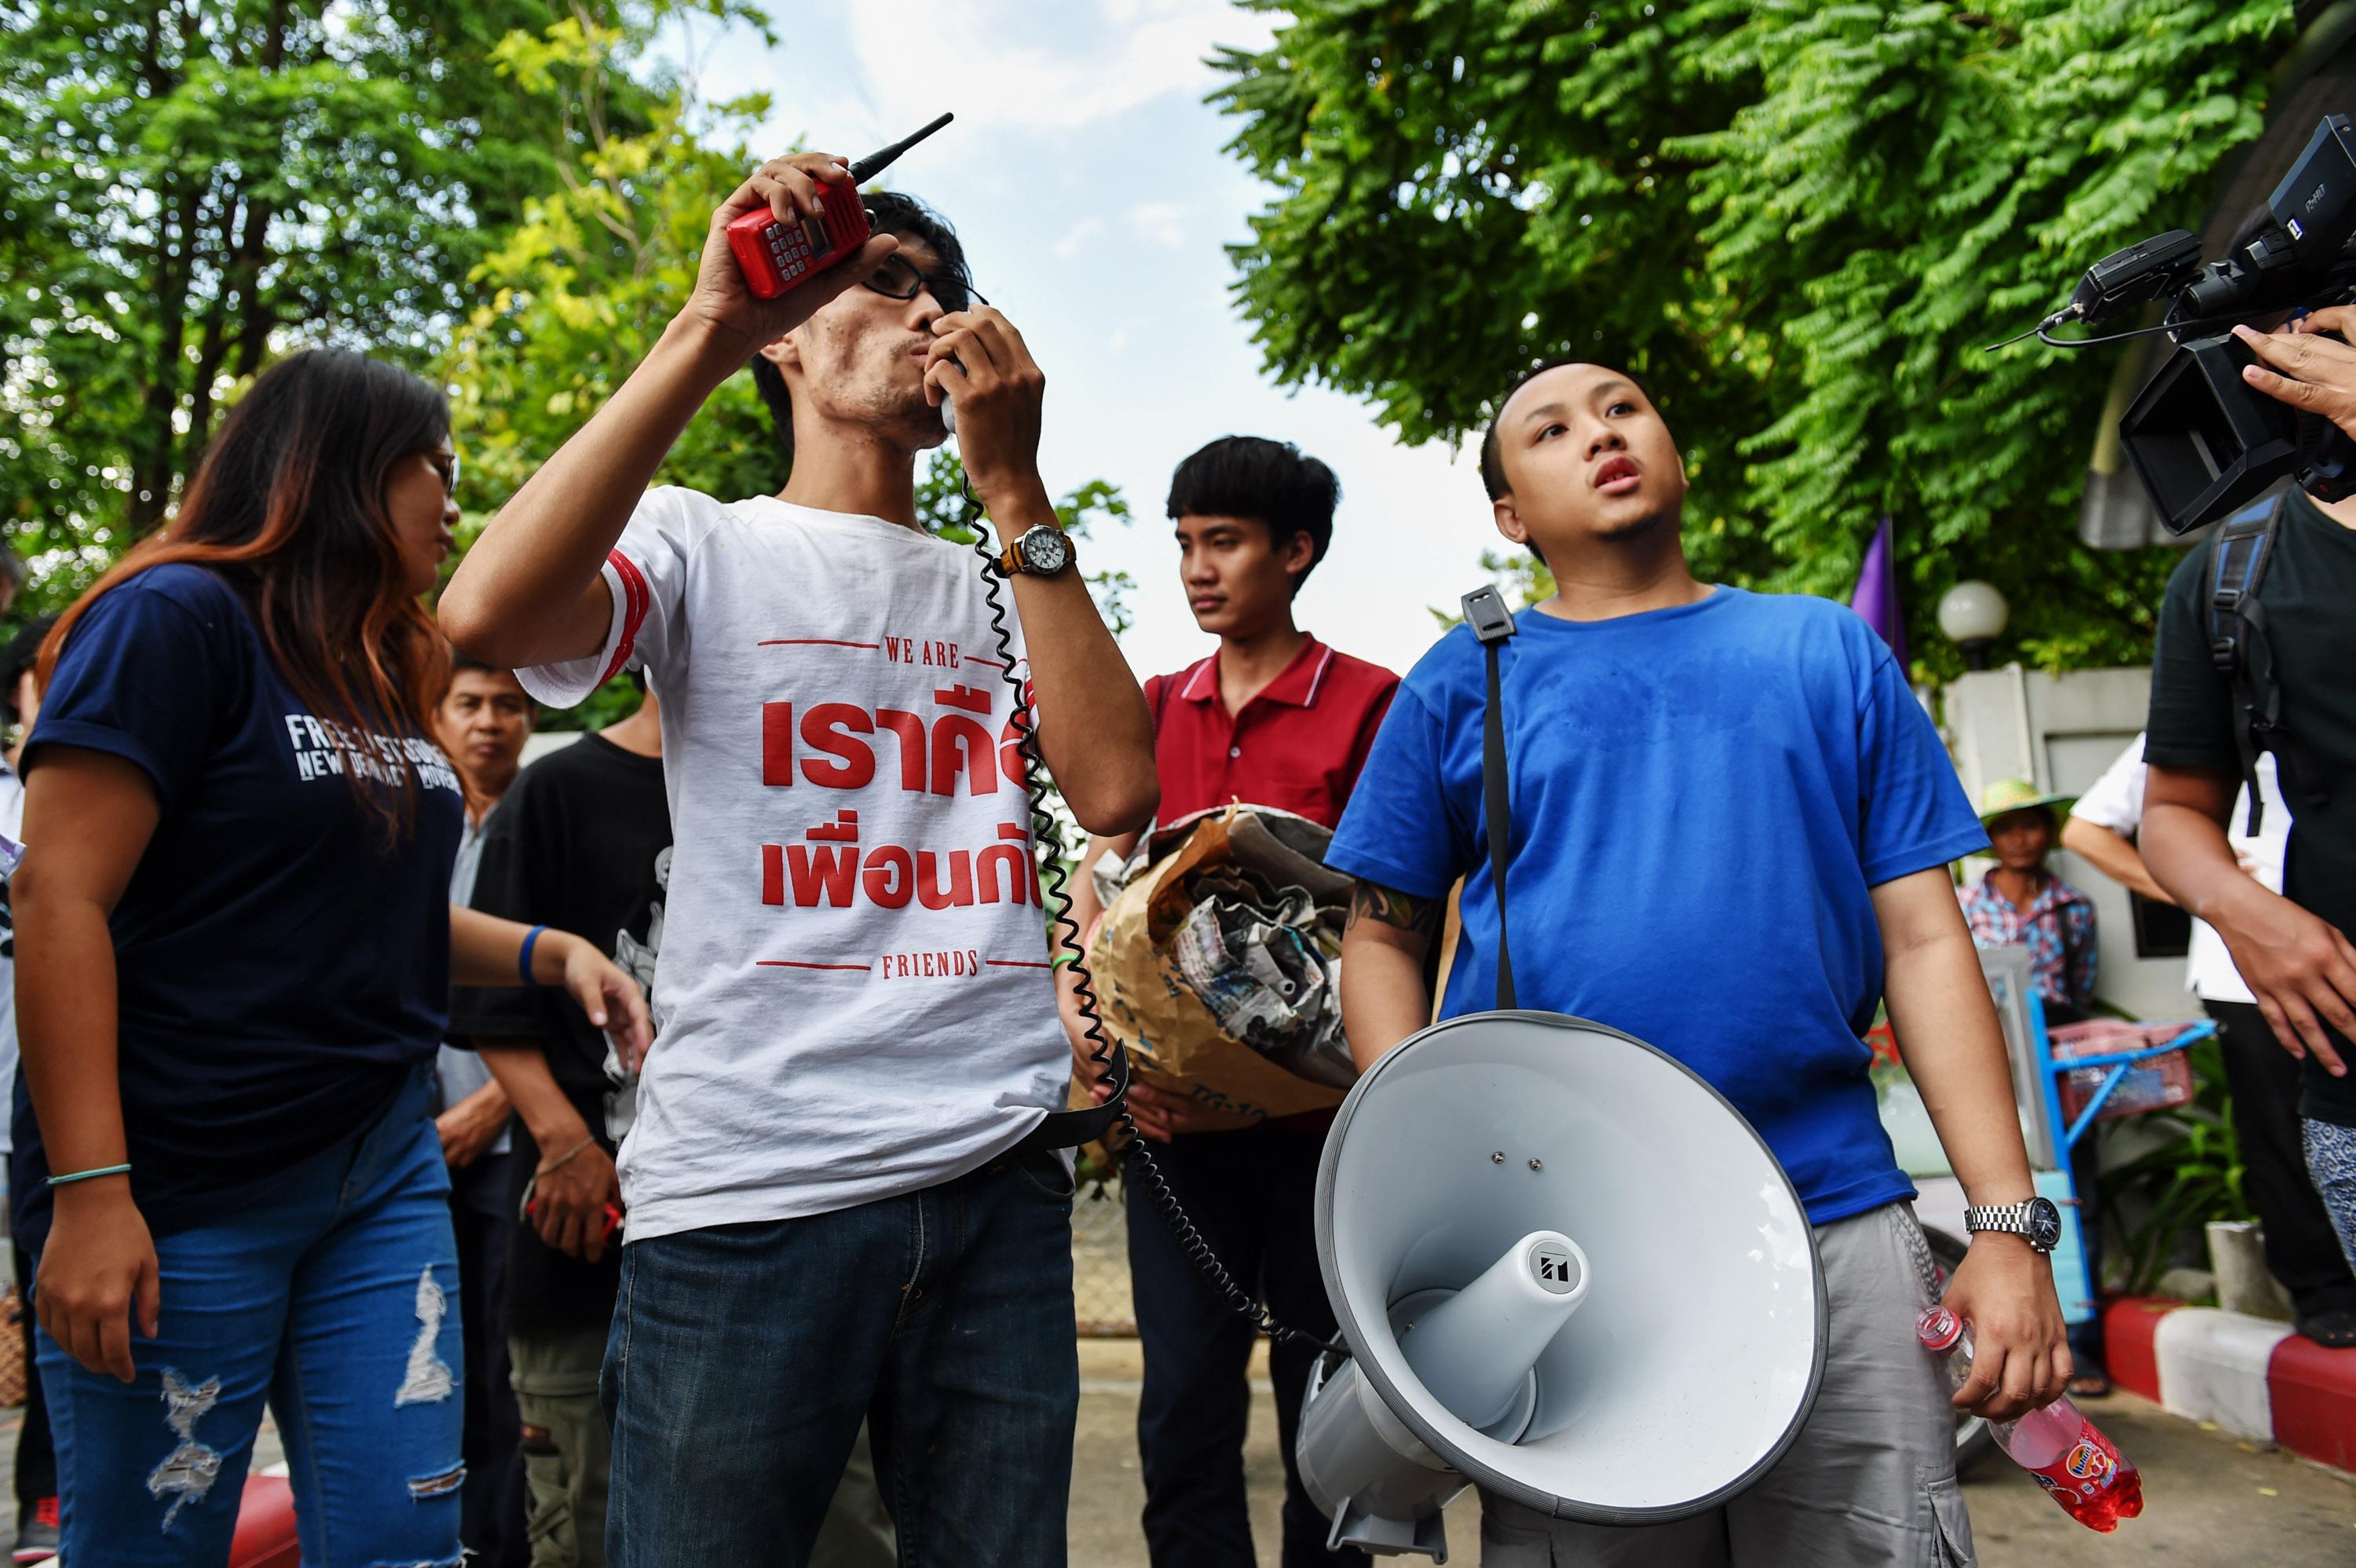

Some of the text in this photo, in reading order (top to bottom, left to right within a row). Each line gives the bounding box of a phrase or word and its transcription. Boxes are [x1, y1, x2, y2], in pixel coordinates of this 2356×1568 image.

[885, 636, 959, 669] WE ARE
[295, 750, 344, 781] NEW
[762, 809, 1044, 911] เพื่อนกั
[883, 950, 978, 979] FRIENDS
